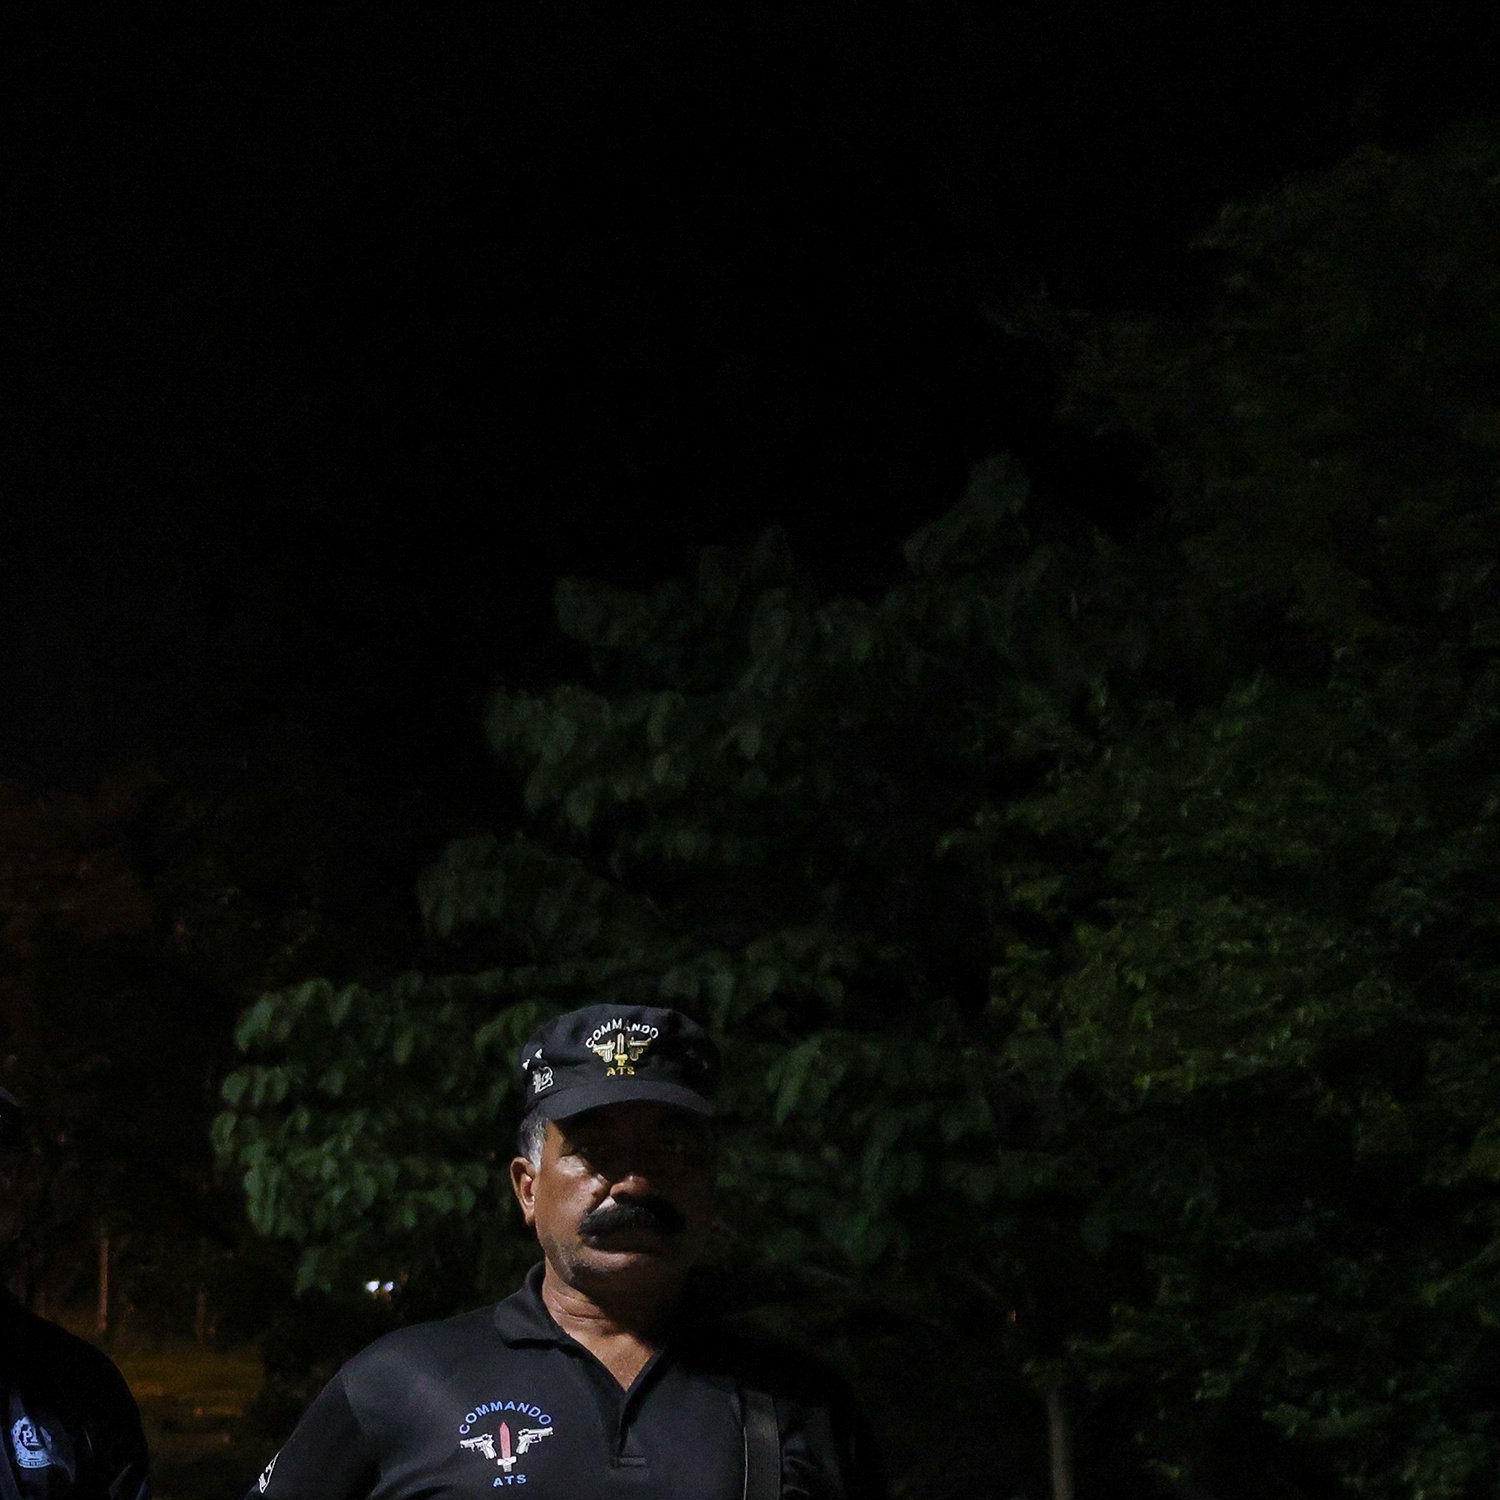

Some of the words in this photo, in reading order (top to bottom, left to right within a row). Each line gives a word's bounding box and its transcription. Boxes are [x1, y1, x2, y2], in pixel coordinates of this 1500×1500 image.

[606, 1066, 636, 1077] ATS
[459, 1400, 552, 1434] COMMANDO
[492, 1474, 527, 1488] ATS
